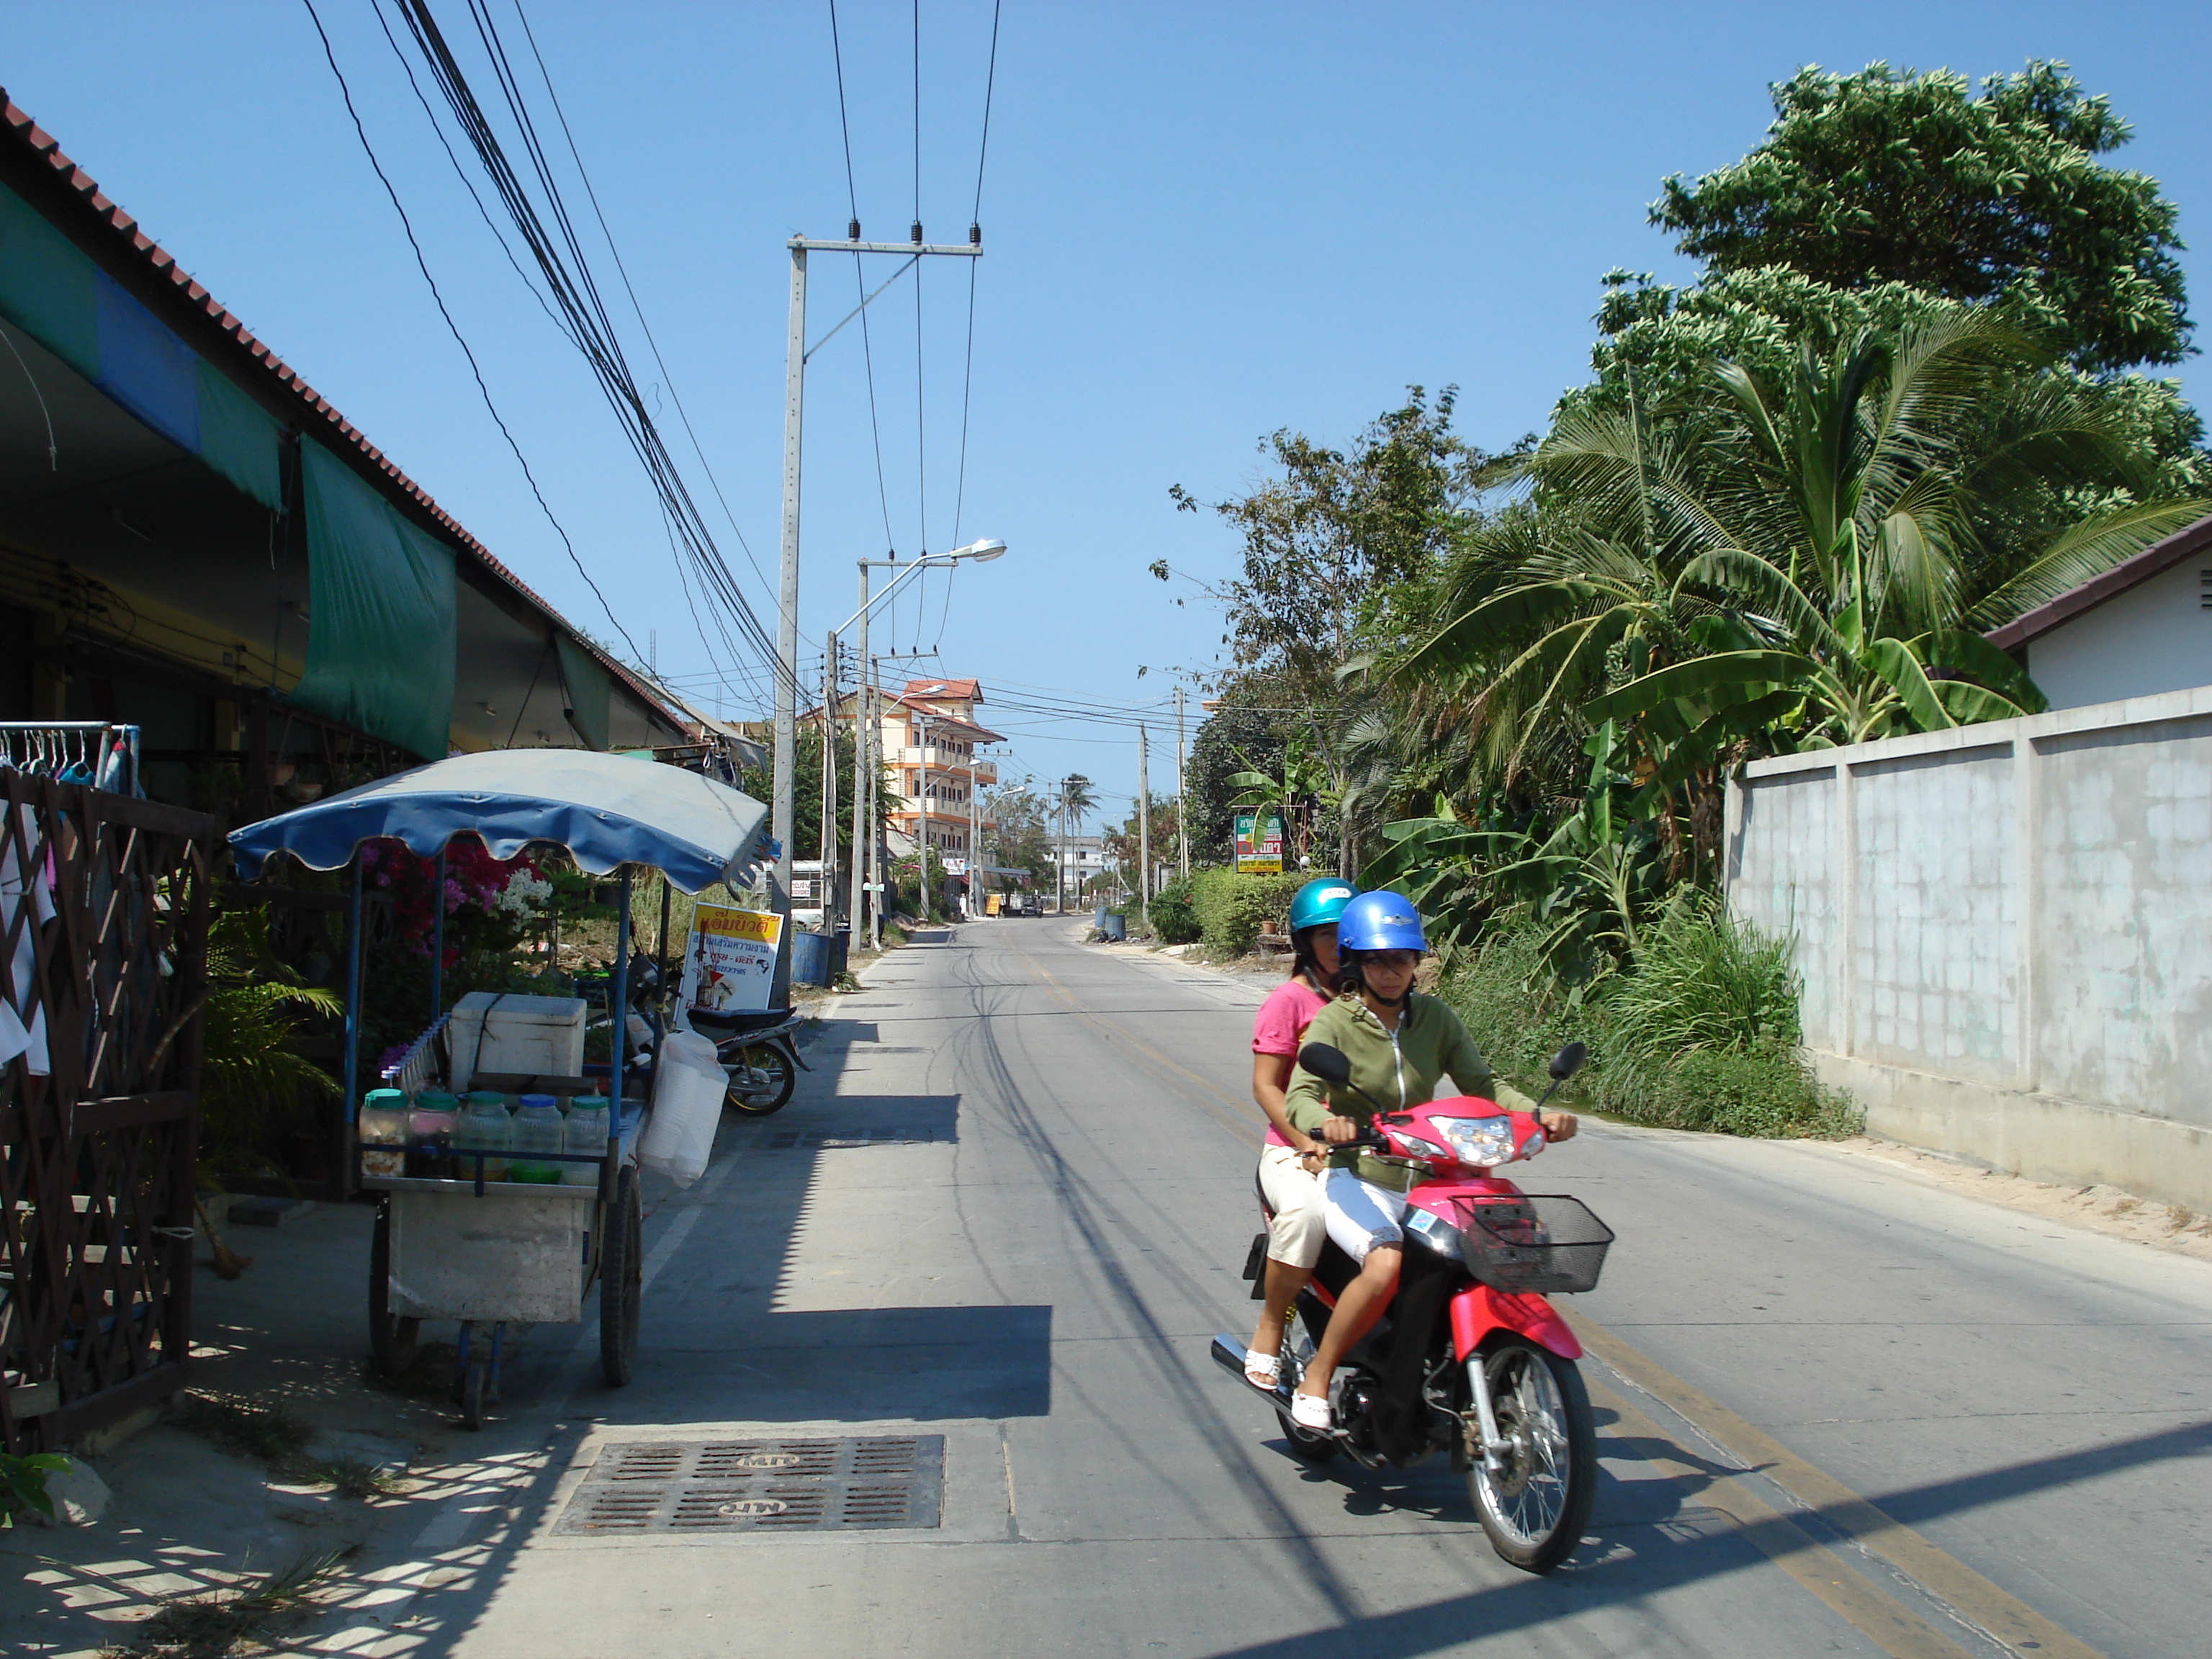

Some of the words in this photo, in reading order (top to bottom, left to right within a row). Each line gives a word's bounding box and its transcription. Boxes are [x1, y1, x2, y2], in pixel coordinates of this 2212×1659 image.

[693, 933, 770, 954] สานเสริมความงาม
